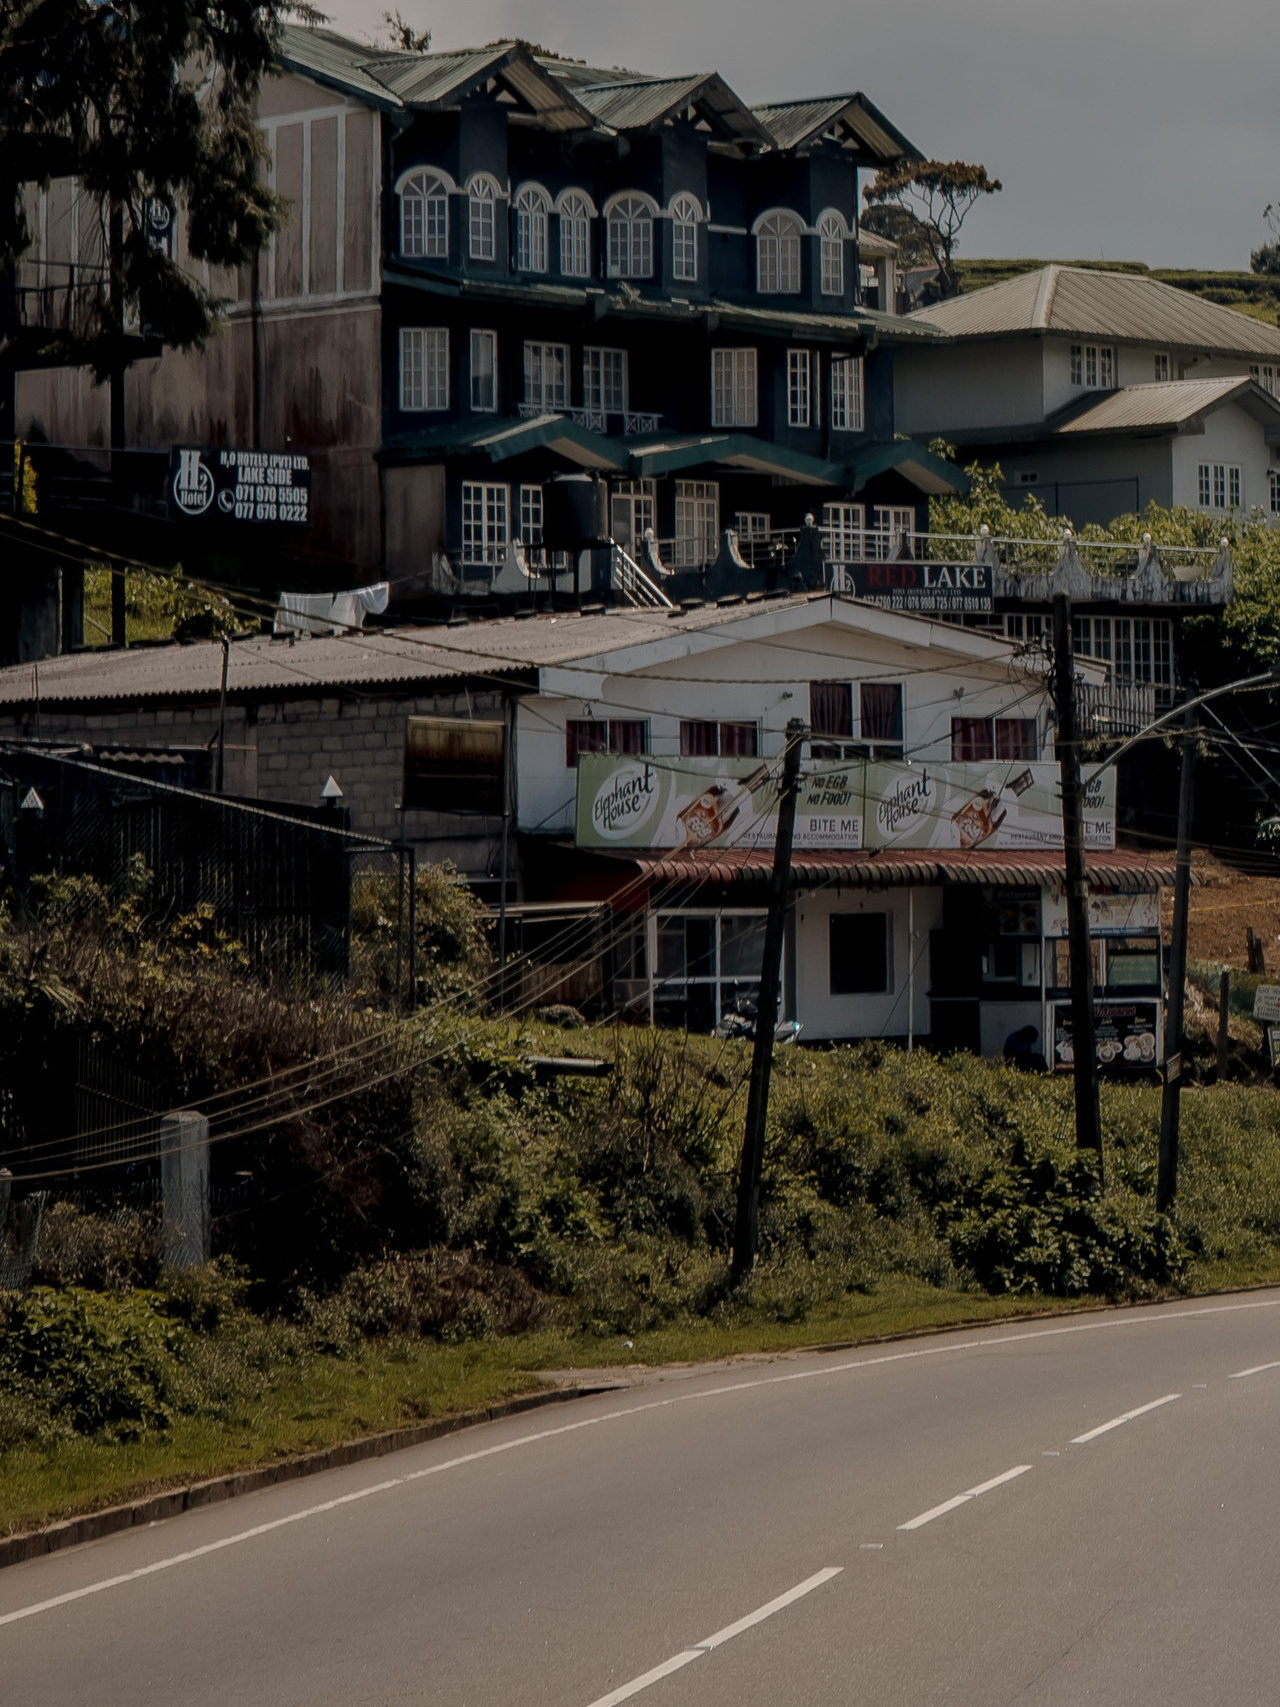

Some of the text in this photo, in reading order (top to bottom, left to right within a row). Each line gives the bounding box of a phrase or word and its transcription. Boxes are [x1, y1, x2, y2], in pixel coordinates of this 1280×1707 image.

[237, 452, 268, 466] HOTELS
[269, 453, 292, 469] (PVT)
[293, 456, 310, 471] LTD.
[238, 467, 292, 485] LAKE SIDE
[180, 490, 207, 506] Hotel
[235, 484, 308, 504] 071 970 5505
[234, 501, 307, 522] 077 676 0222
[868, 565, 986, 588] RED LAKE
[892, 596, 903, 609] 222
[908, 596, 919, 609] 076
[594, 763, 654, 821] Elephant
[811, 777, 825, 789] NO
[807, 792, 852, 806] NO FOOD!
[1083, 796, 1106, 808] OOD!
[603, 794, 642, 831] House
[886, 797, 920, 833] House
[810, 820, 859, 832] BITE ME
[802, 833, 859, 841] ACCOMMODATION
